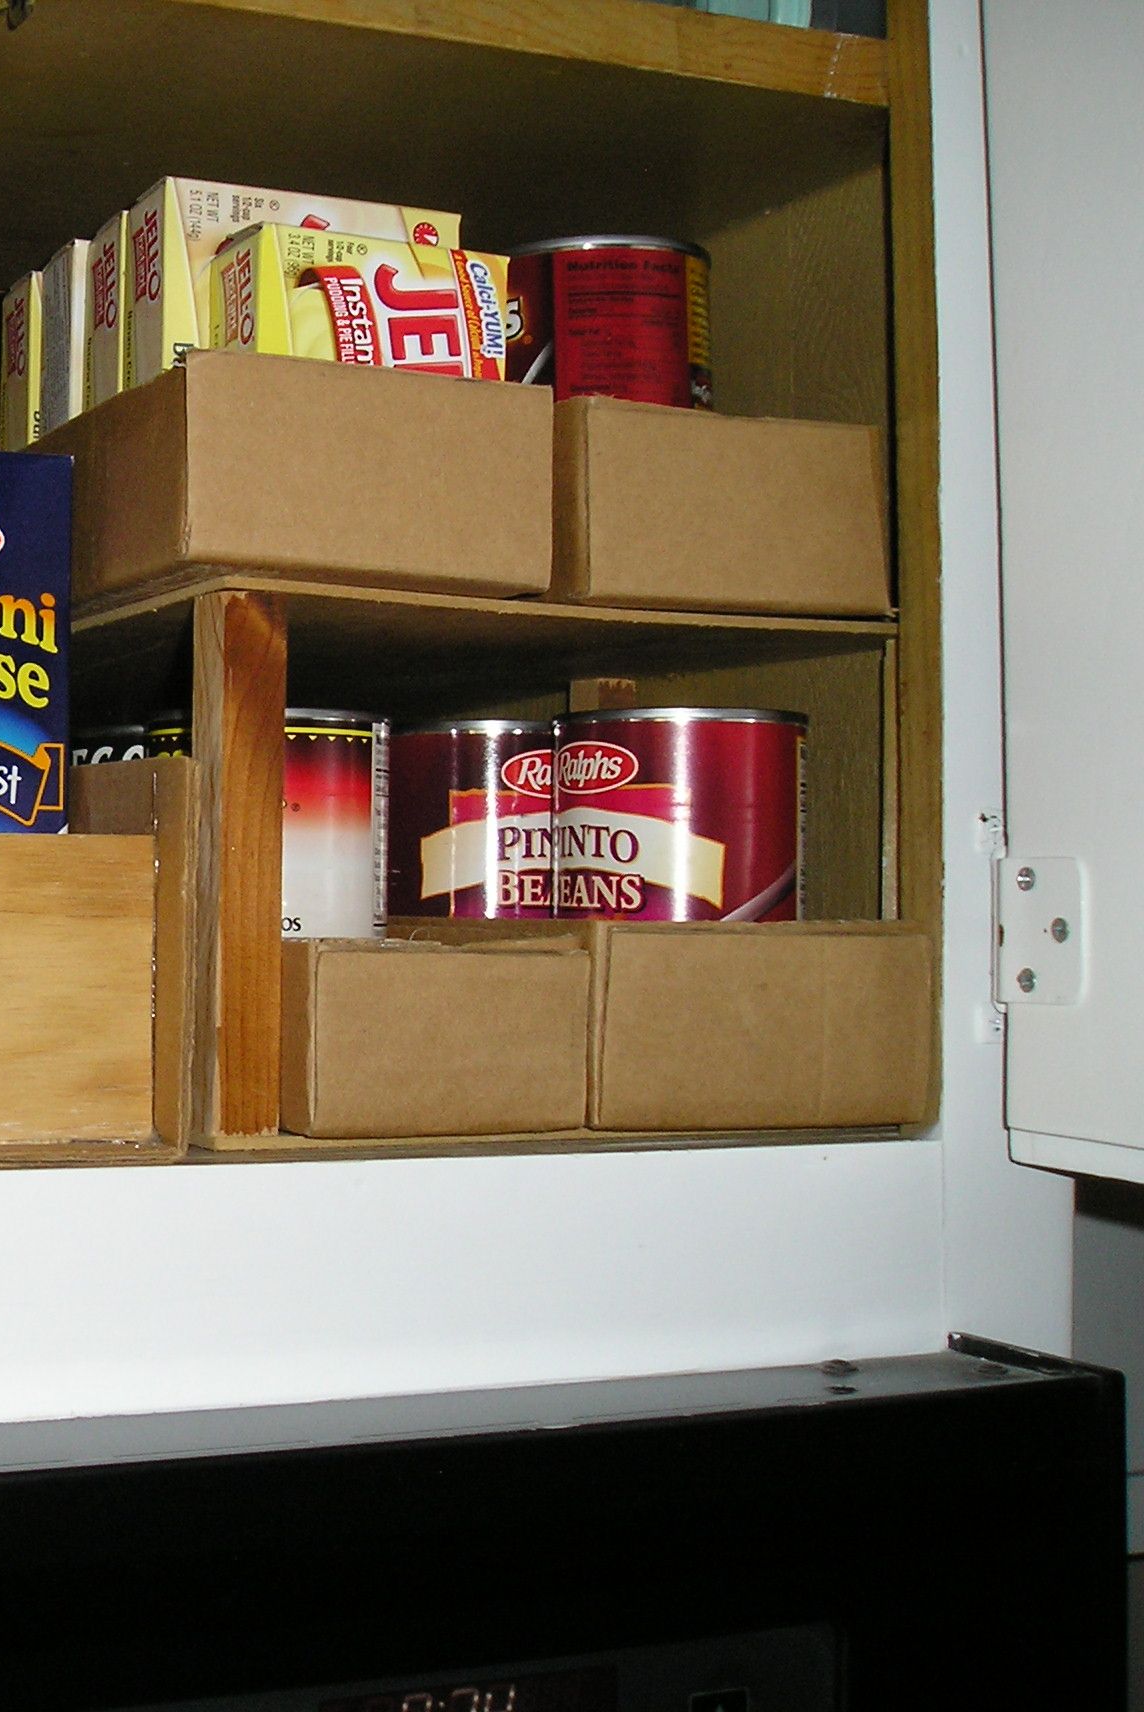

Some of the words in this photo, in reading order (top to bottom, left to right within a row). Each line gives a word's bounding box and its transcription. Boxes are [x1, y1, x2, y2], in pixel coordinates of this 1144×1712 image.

[324, 277, 349, 318] PUDDING
[337, 327, 353, 343] PIE
[468, 261, 504, 356] Calci-YUM!
[559, 750, 623, 788] Ralphs
